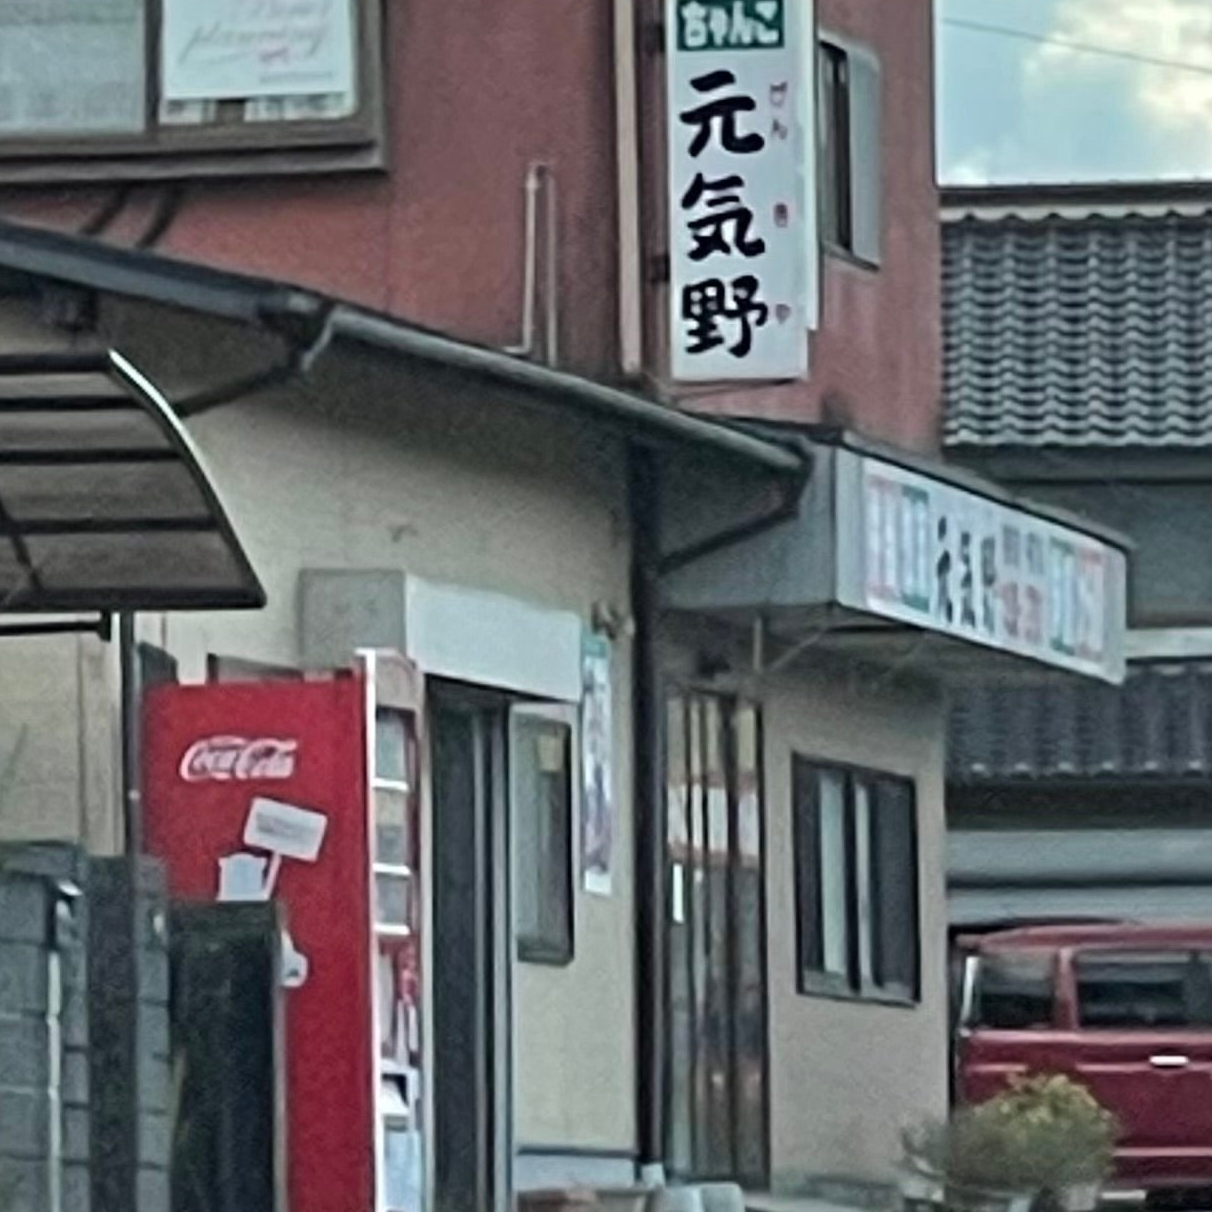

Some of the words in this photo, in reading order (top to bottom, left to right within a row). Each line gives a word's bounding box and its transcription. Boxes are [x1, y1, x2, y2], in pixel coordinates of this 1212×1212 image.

[681, 0, 779, 48] ちゃんこ
[679, 70, 768, 359] 元気野
